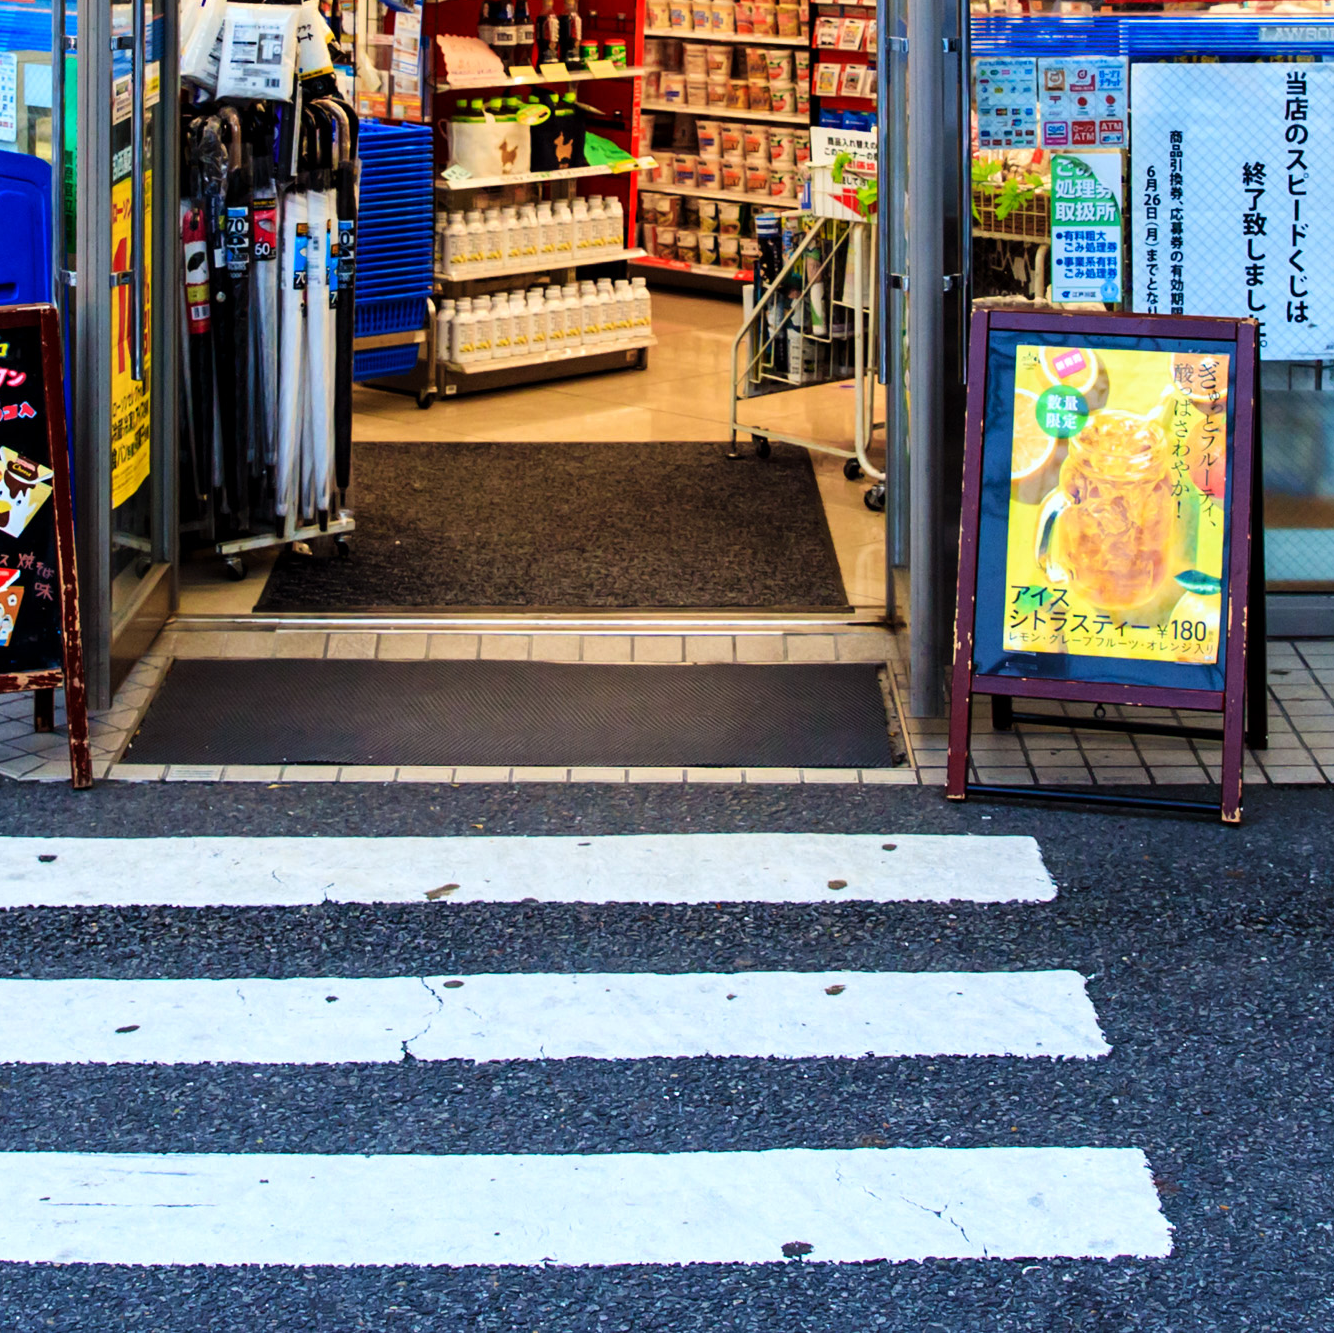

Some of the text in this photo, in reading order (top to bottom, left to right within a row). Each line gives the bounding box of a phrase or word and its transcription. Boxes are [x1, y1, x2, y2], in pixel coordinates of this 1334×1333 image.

[1101, 122, 1123, 131] ATM
[1073, 132, 1095, 141] ATM
[1285, 71, 1310, 324] 当店のスピードくじは
[1055, 201, 1116, 222] 取扱所
[254, 243, 270, 257] 60
[1071, 291, 1097, 299] 江戸川区
[1046, 394, 1079, 412] 数量
[1045, 412, 1078, 430] 限定
[1010, 584, 1070, 609] アイス
[1008, 608, 1151, 638] シトラスティー
